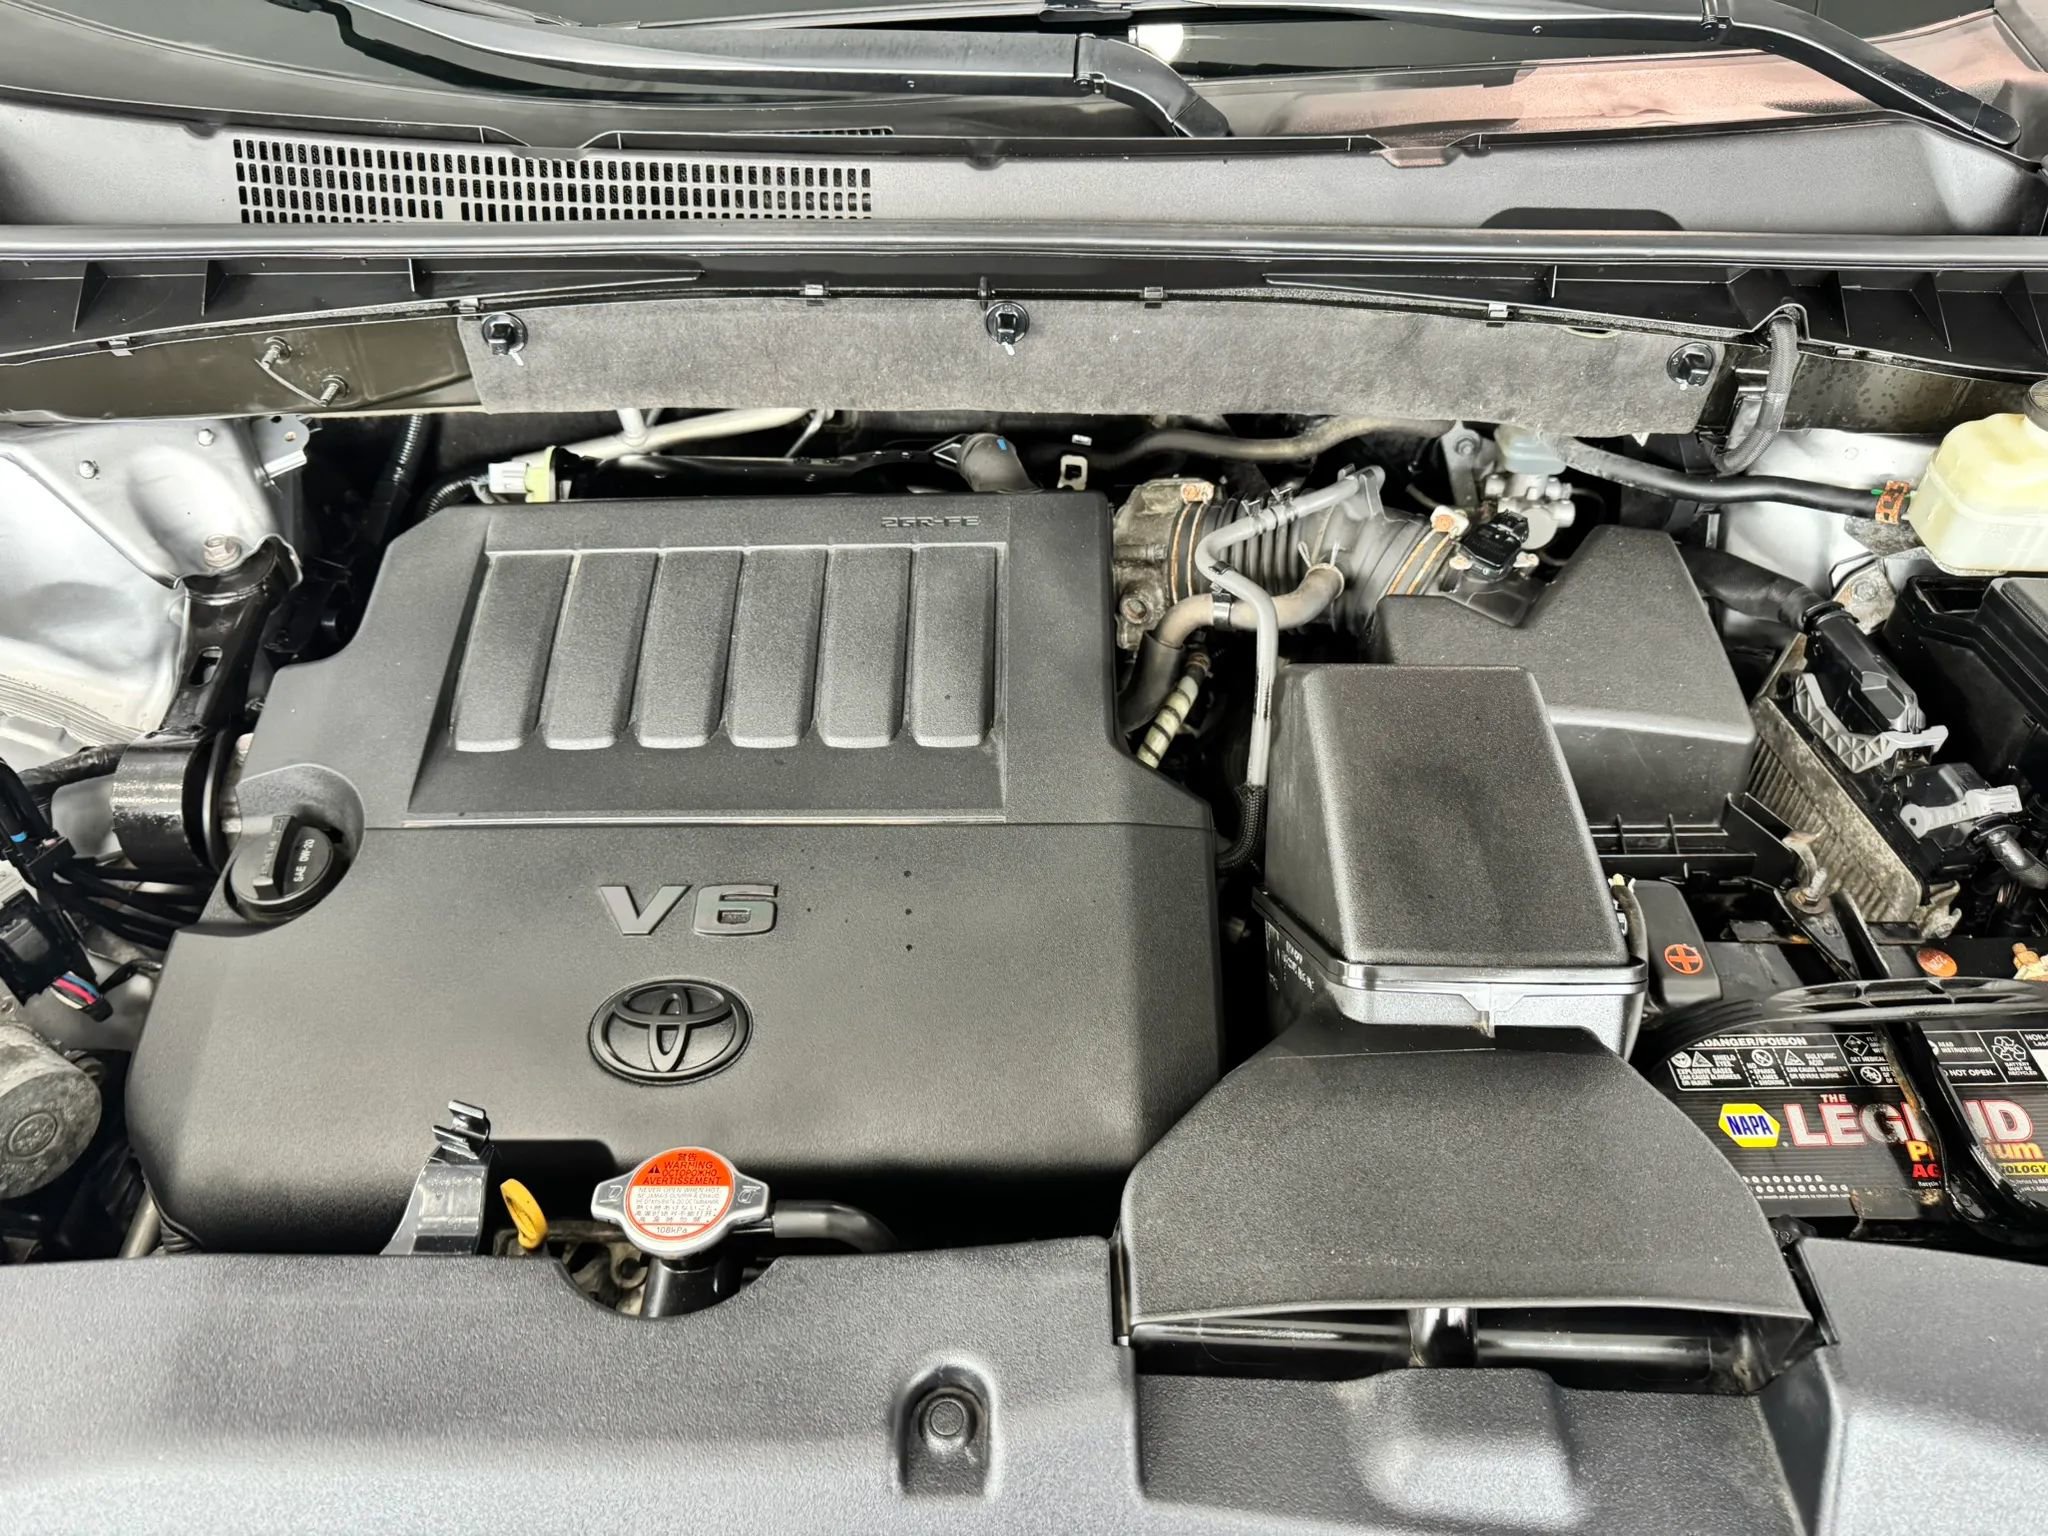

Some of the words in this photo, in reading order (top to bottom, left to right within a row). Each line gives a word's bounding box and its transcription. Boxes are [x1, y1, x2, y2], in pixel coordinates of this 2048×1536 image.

[881, 516, 980, 528] 2GR-FE
[293, 865, 307, 882] SAE
[600, 884, 780, 935] V6
[1704, 1037, 1808, 1047] DANGER/POISON
[1968, 1068, 1996, 1076] OPEN.
[1820, 1093, 1847, 1103] THE
[1726, 1114, 1773, 1137] NAPA
[664, 1161, 713, 1169] WARNING
[642, 1177, 722, 1185] AVERTISSEMENT
[656, 1226, 688, 1235] 108kPa
